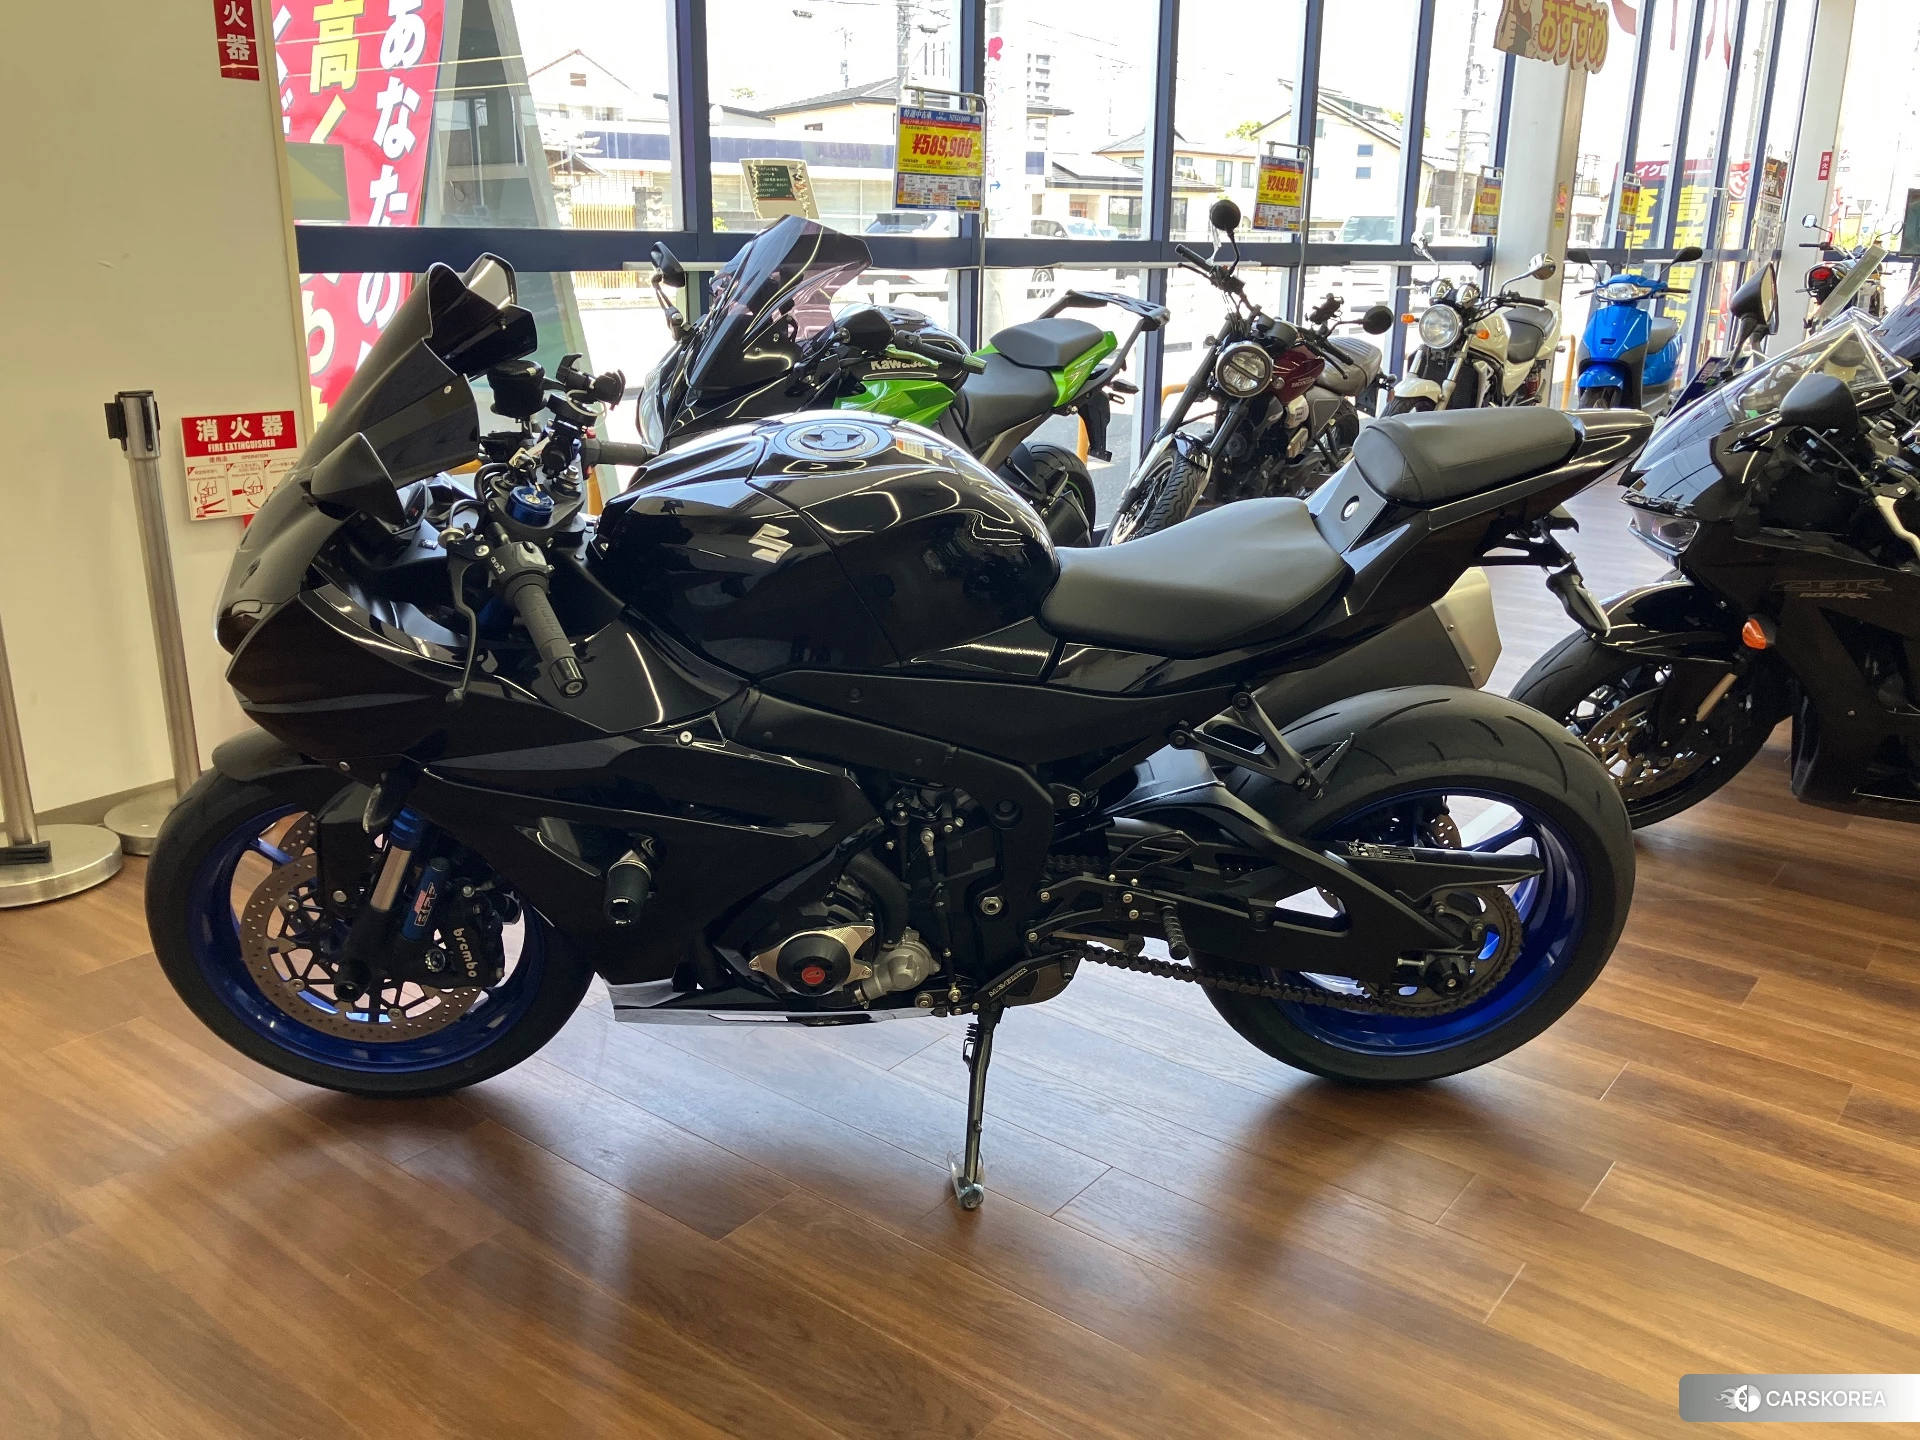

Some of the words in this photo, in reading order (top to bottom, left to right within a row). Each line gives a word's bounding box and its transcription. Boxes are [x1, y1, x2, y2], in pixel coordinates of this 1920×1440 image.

[1538, 1, 1608, 68] おすすめ
[912, 133, 973, 158] ¥589,900
[196, 414, 283, 442] 消火器
[207, 442, 224, 453] FIRE
[225, 439, 276, 452] EXTINGUISHER
[453, 927, 478, 978] brembo
